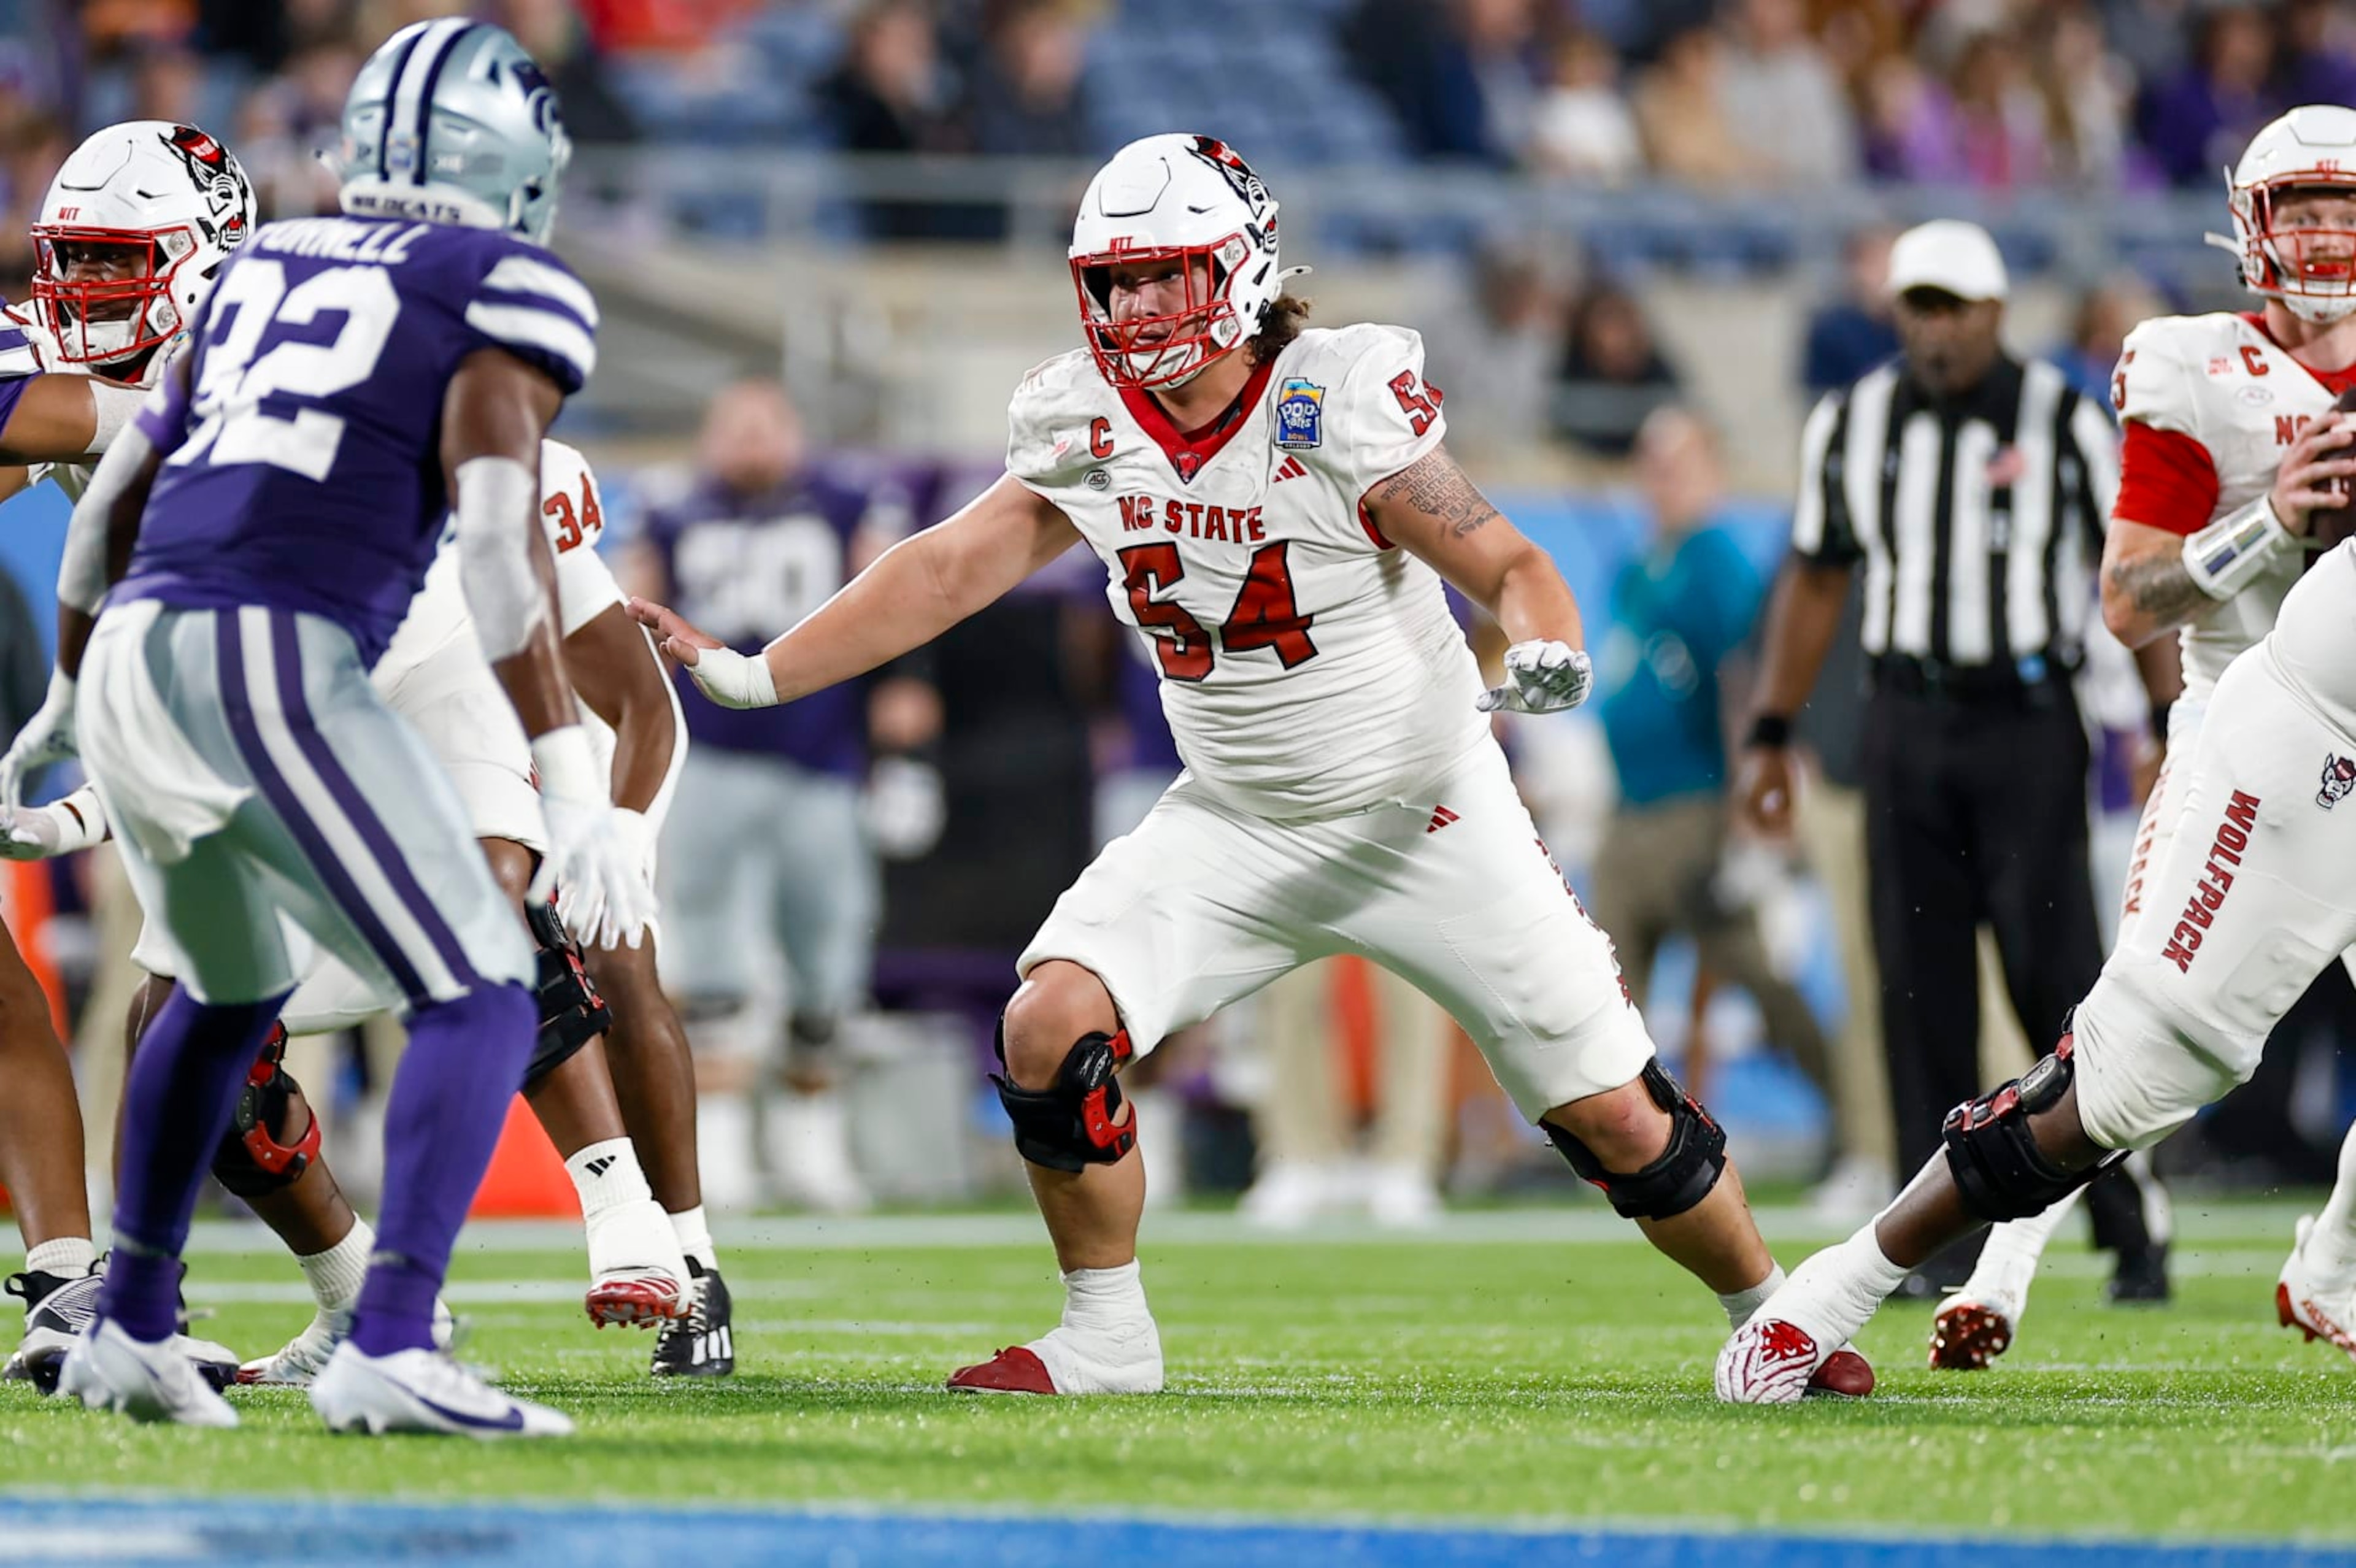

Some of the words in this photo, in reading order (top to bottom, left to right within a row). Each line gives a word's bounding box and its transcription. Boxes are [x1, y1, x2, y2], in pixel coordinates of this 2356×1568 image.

[2239, 345, 2270, 377] C
[1090, 416, 1114, 459] C
[542, 471, 602, 555] 34
[1118, 496, 1154, 531] NC
[1165, 499, 1266, 544] STATE
[1115, 538, 1320, 682] 54
[2161, 789, 2262, 974] WOLFPACK
